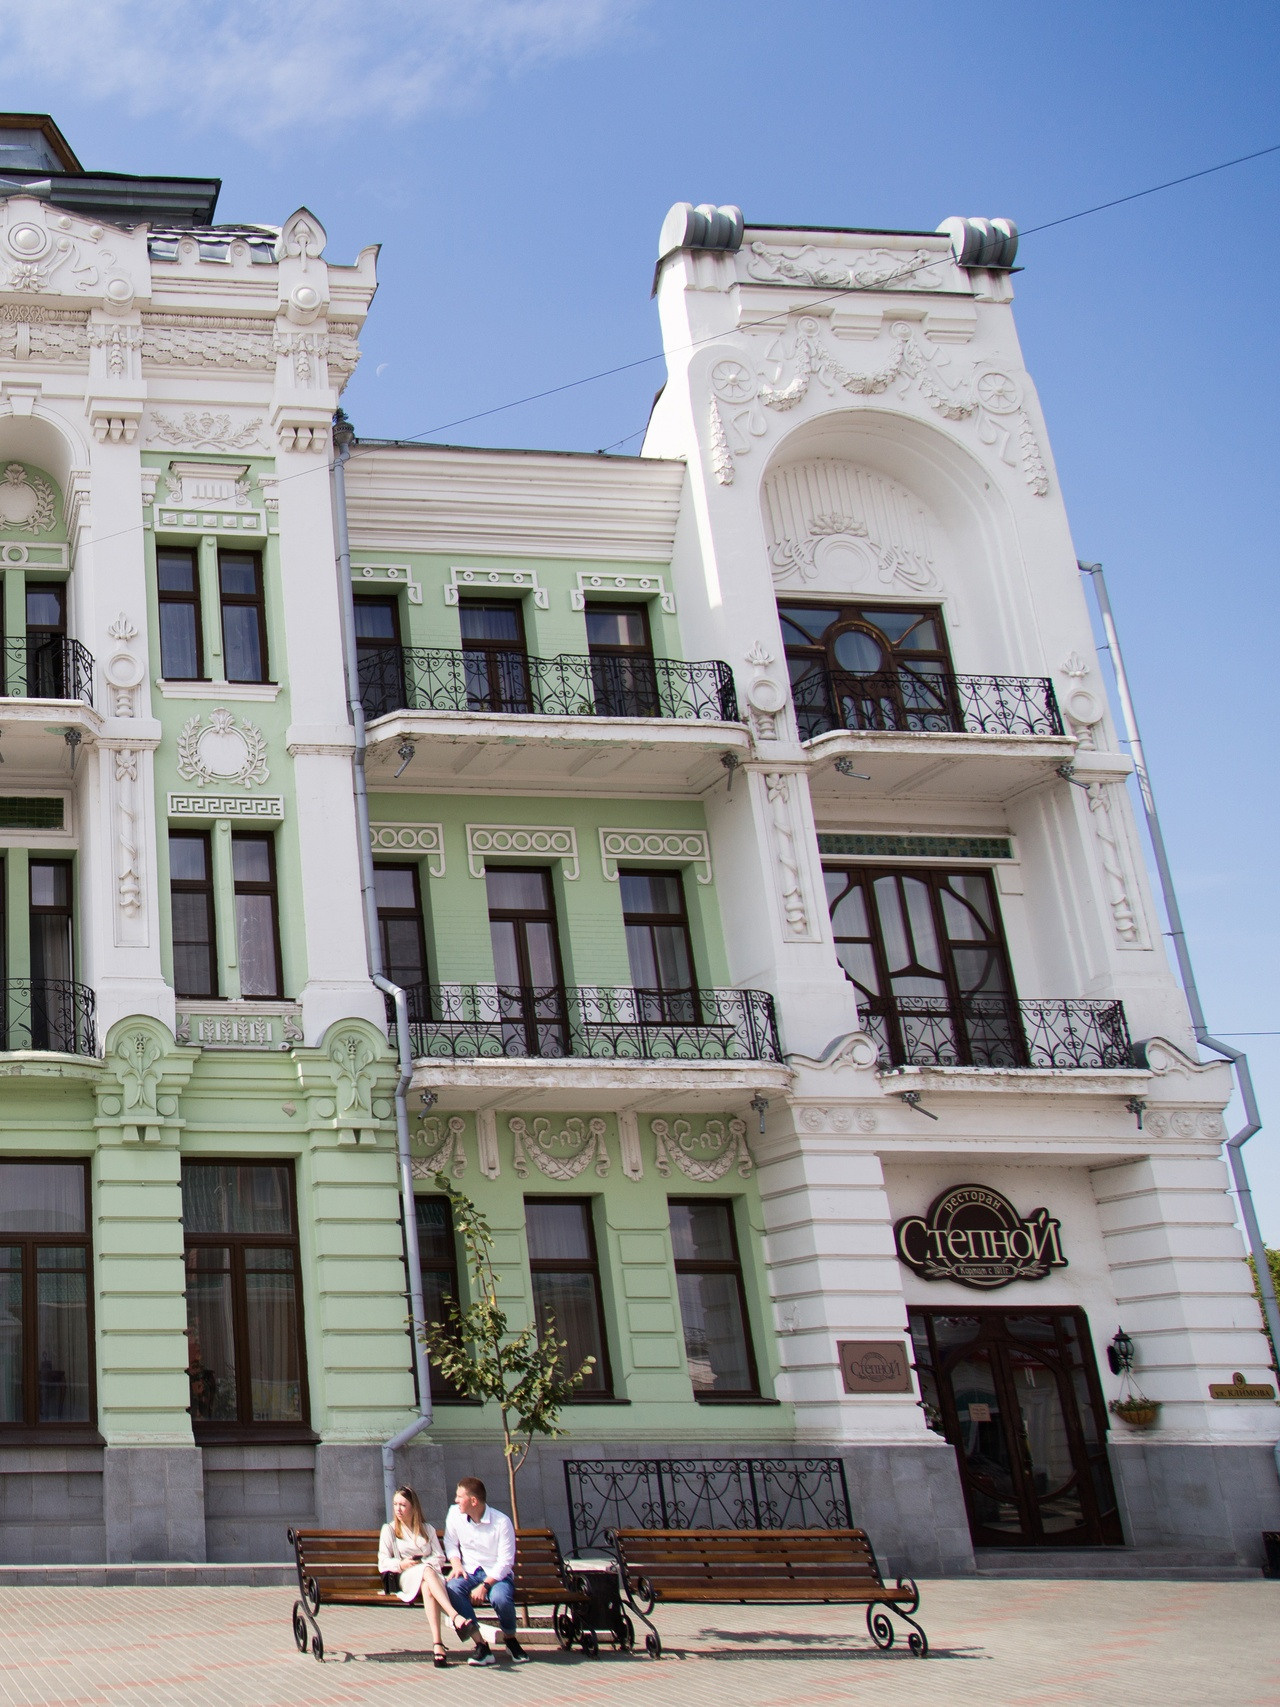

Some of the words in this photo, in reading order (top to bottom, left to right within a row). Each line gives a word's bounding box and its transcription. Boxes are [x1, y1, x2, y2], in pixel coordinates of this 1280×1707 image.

[943, 1191, 1002, 1214] ресторан
[1236, 1375, 1243, 1383] 9
[1227, 1389, 1271, 1397] КЛИМОВА
